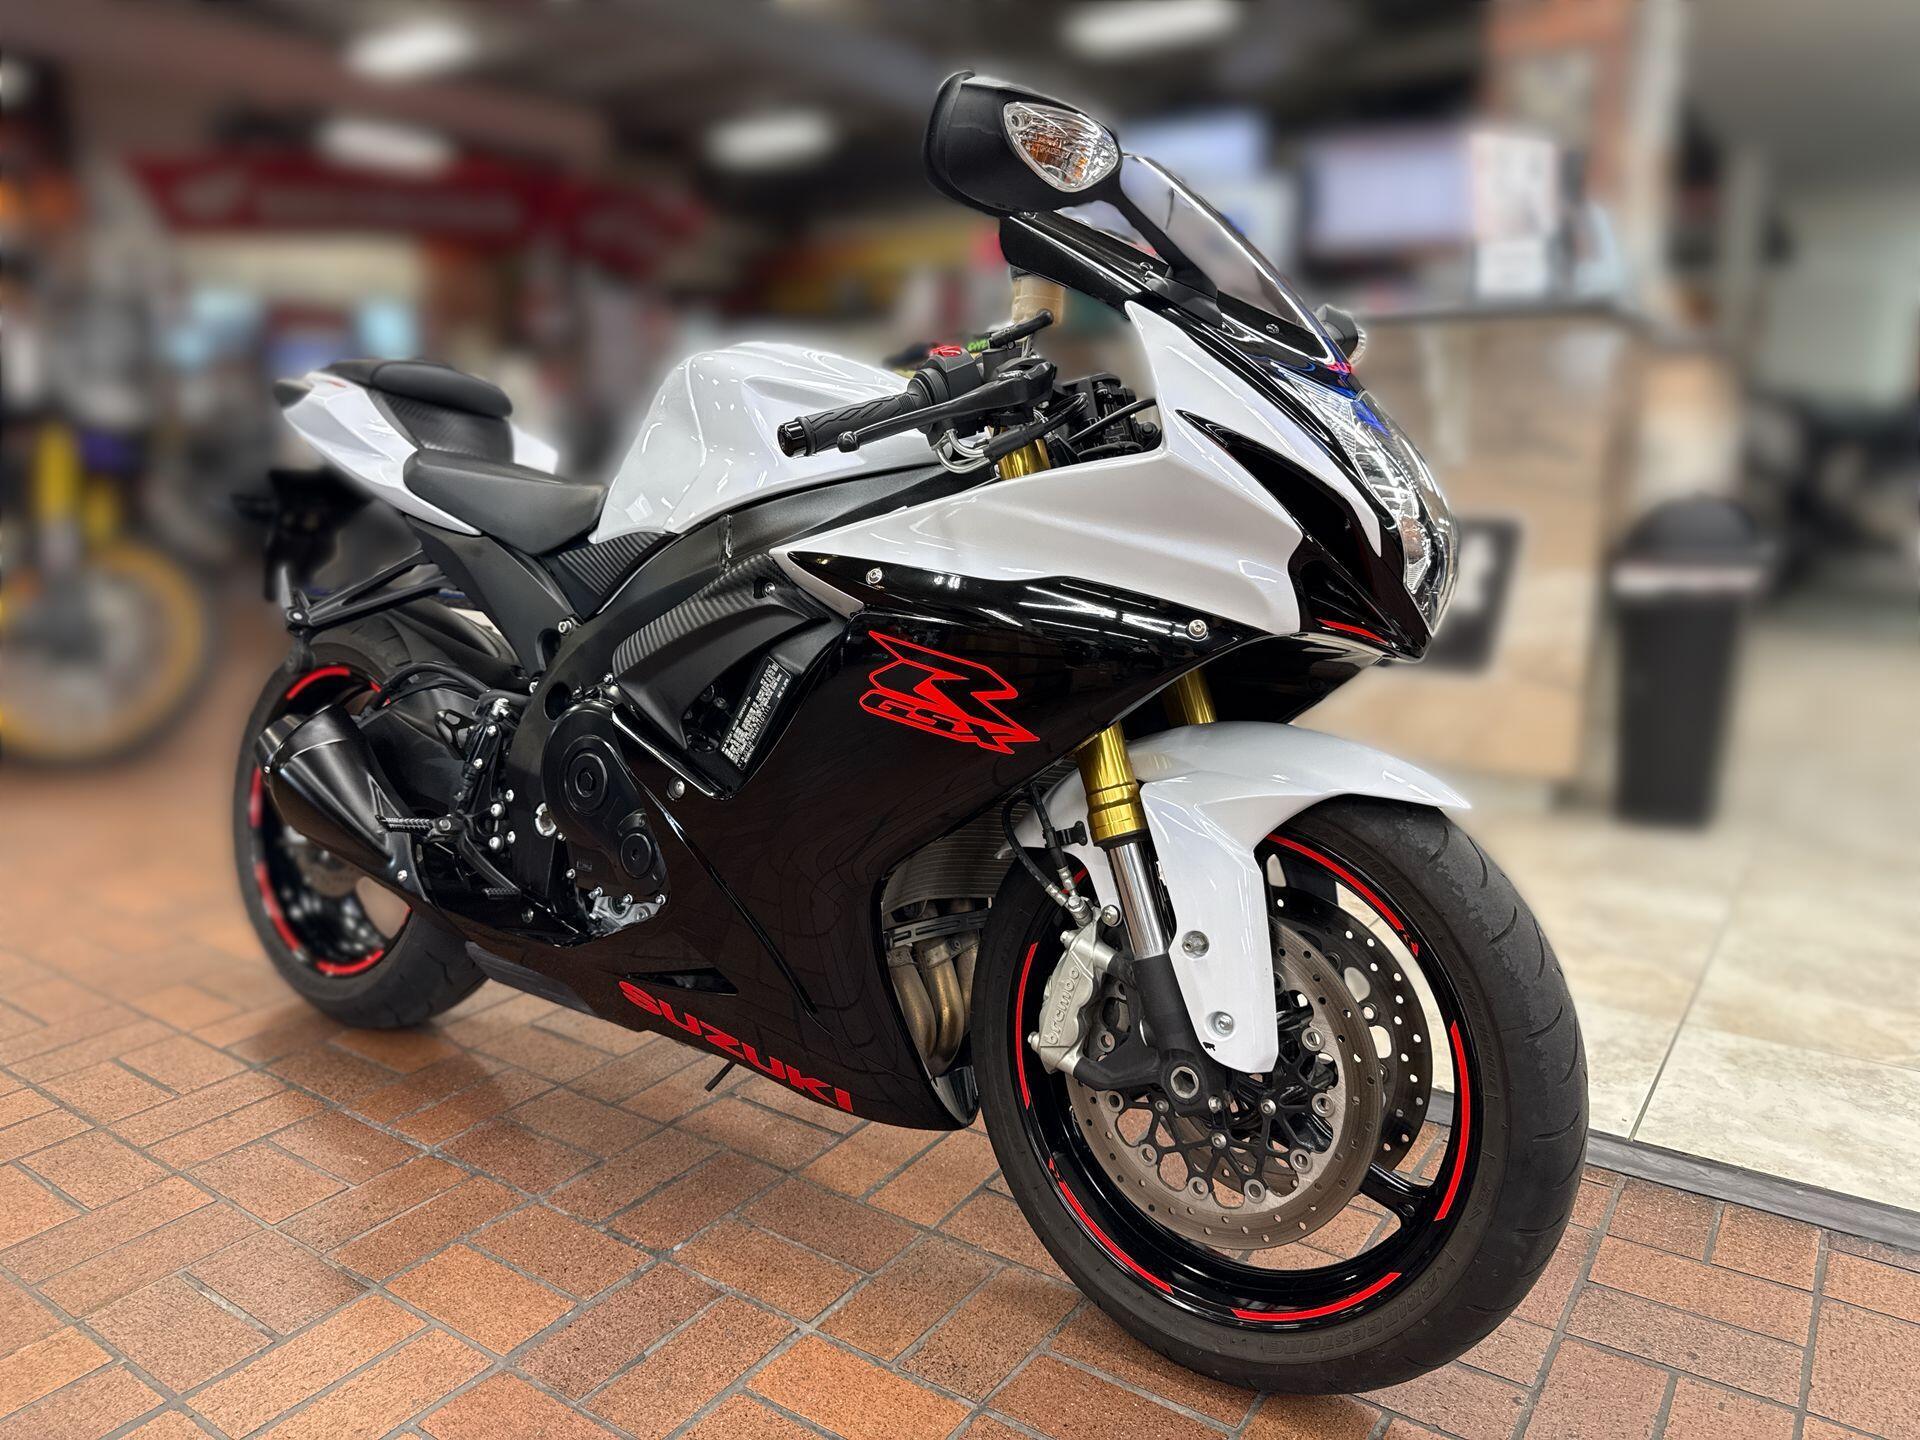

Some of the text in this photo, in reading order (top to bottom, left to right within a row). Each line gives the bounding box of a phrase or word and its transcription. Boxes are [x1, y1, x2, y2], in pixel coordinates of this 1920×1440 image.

[618, 981, 854, 1112] SUZUKI
[1043, 967, 1081, 1046] brembo
[1268, 1274, 1441, 1355] BRIDGESTONE
